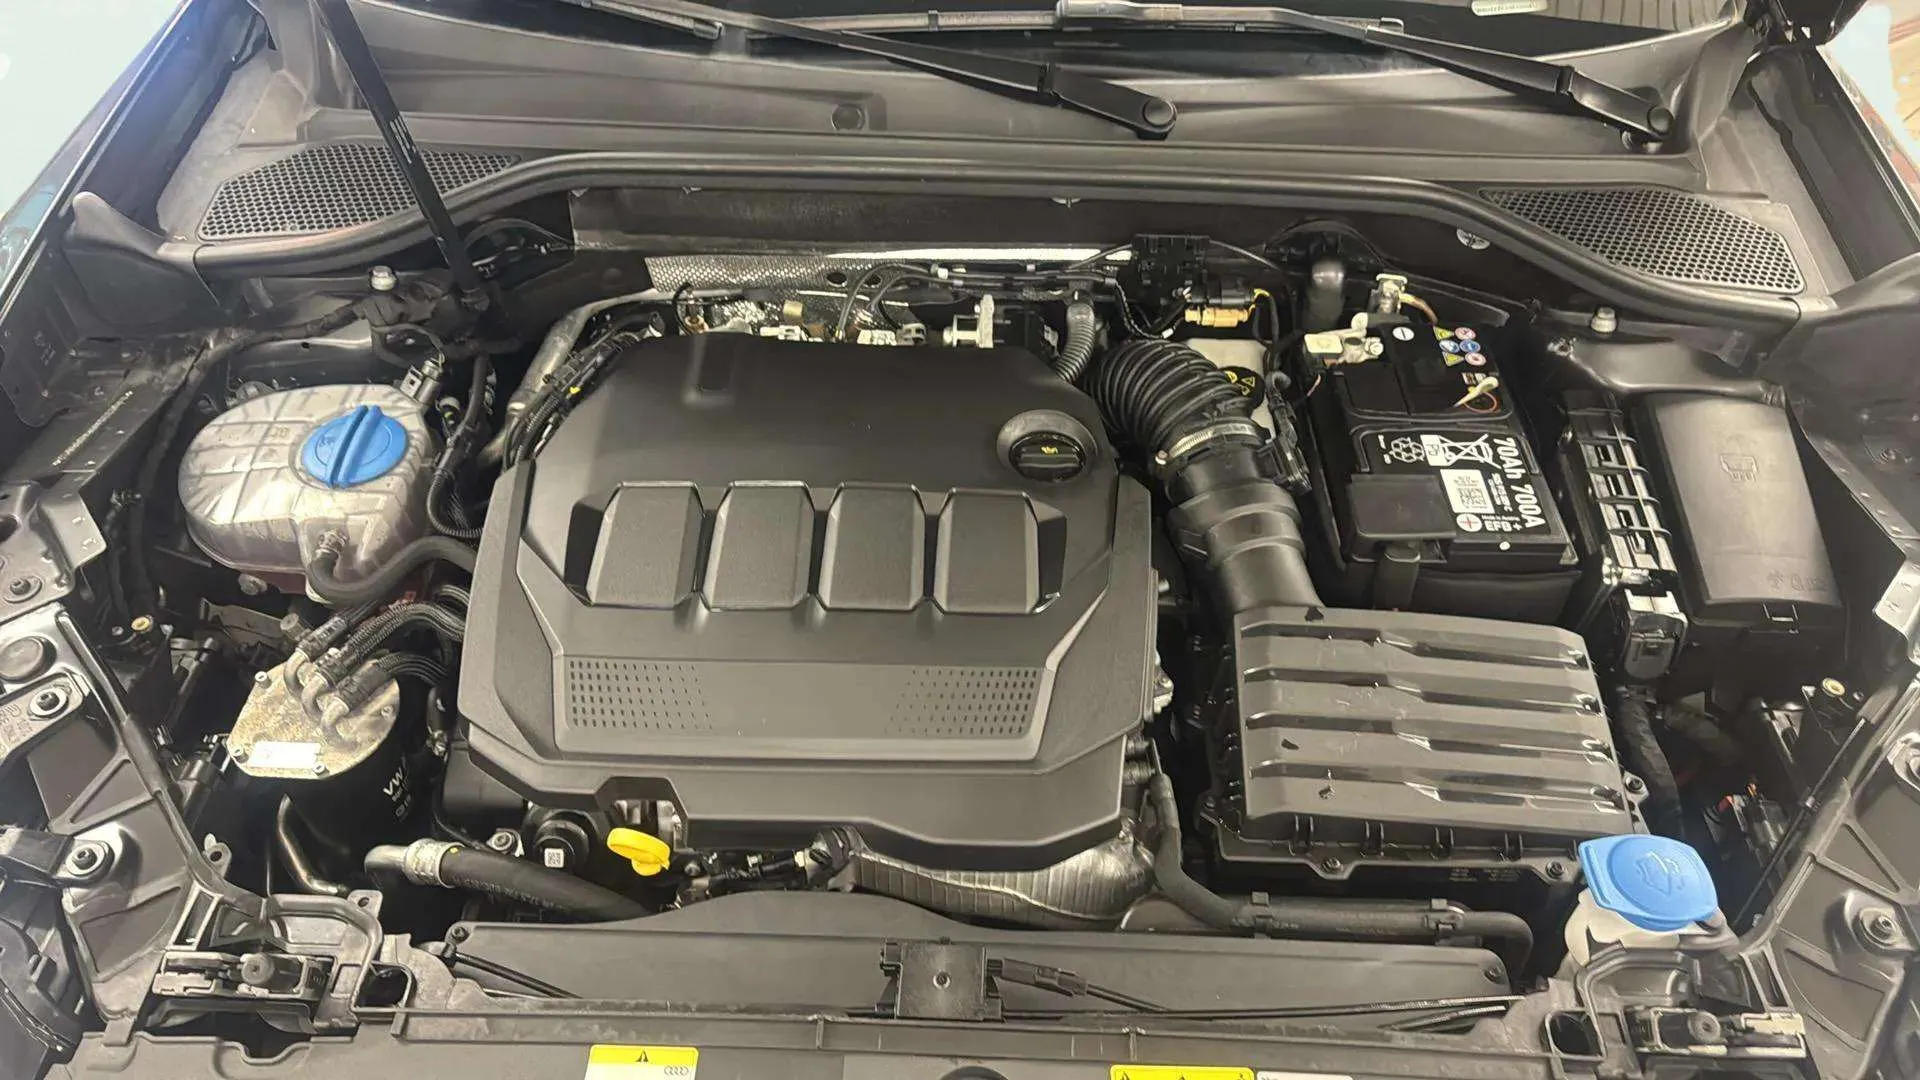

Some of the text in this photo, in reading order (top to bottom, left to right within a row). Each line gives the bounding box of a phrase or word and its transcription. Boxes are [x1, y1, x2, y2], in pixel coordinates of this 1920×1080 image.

[1493, 437, 1526, 479] 70Ah
[1510, 484, 1546, 528] 700A
[382, 766, 403, 796] VW
